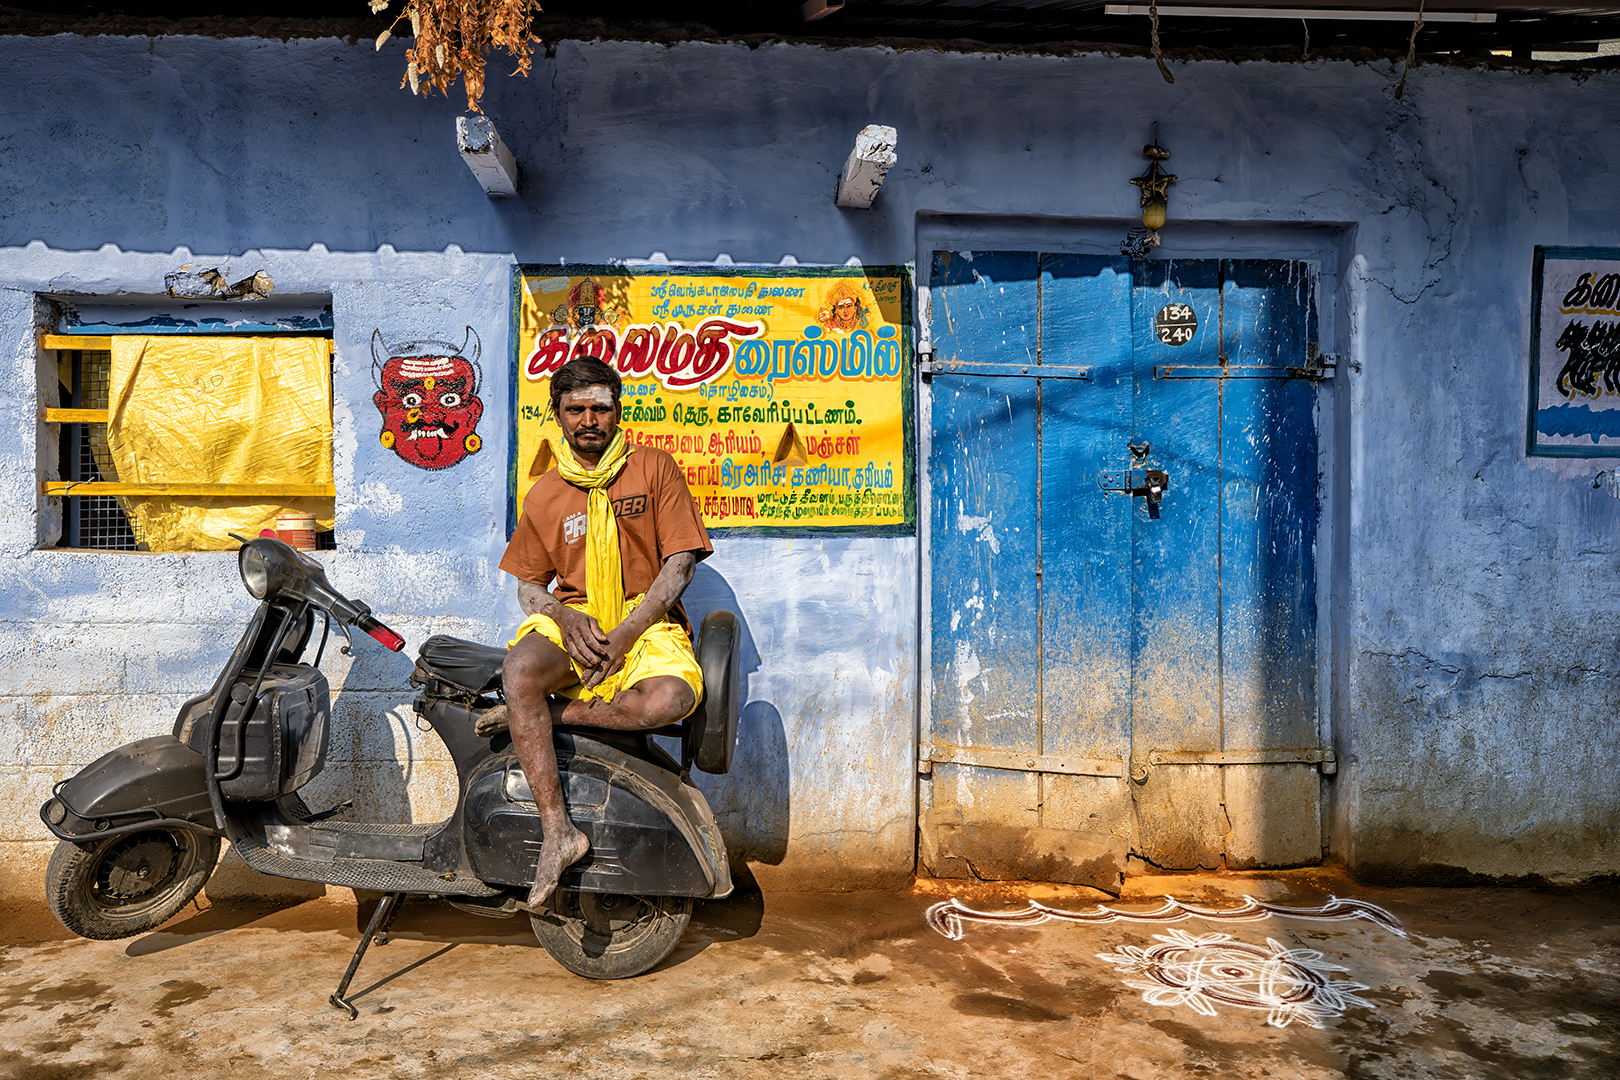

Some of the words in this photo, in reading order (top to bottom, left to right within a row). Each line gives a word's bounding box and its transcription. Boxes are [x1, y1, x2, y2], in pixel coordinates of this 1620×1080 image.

[671, 298, 724, 318] முருகன்
[1162, 306, 1192, 321] 134
[1161, 327, 1193, 342] 240
[525, 319, 761, 388] கலைமதி
[735, 325, 901, 382] ரைஸ்மில்
[672, 402, 714, 427] தெரு,
[717, 400, 863, 425] காவேரிப்பட்டணம்.
[805, 429, 861, 459] மஞ்சள்
